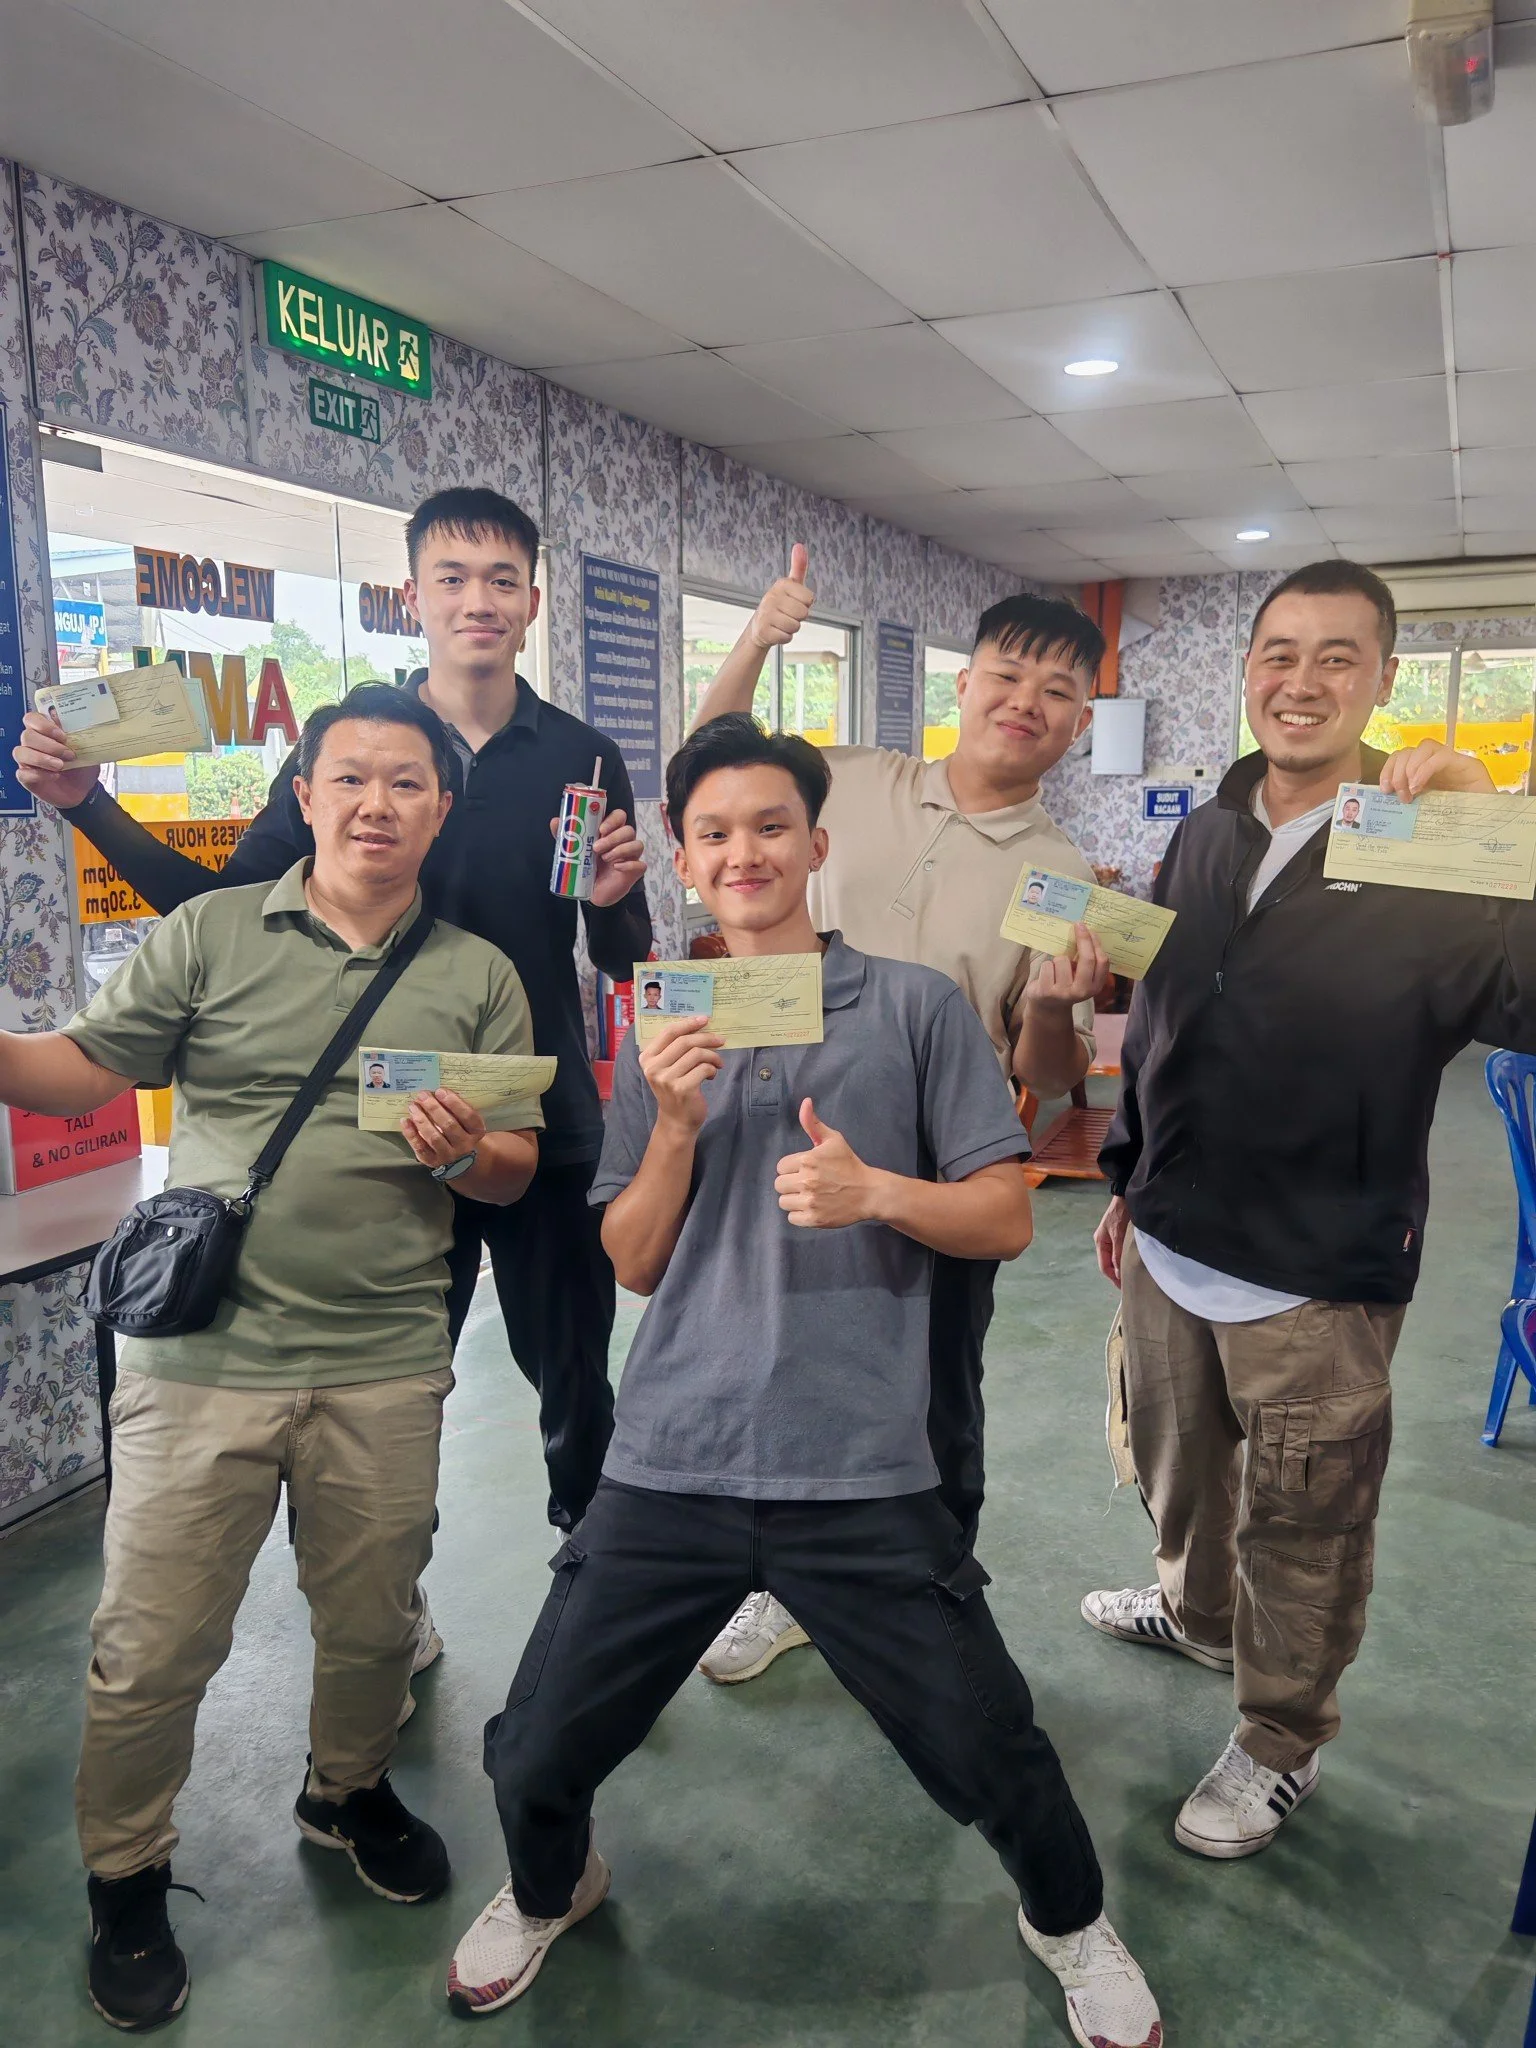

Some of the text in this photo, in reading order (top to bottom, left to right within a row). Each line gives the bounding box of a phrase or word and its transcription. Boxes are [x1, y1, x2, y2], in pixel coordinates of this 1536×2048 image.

[278, 280, 390, 372] KELUAR
[313, 387, 356, 429] EXIT
[583, 835, 595, 867] PLUS
[64, 1113, 94, 1133] TALI
[32, 1129, 128, 1168] & NO GILIRAN
